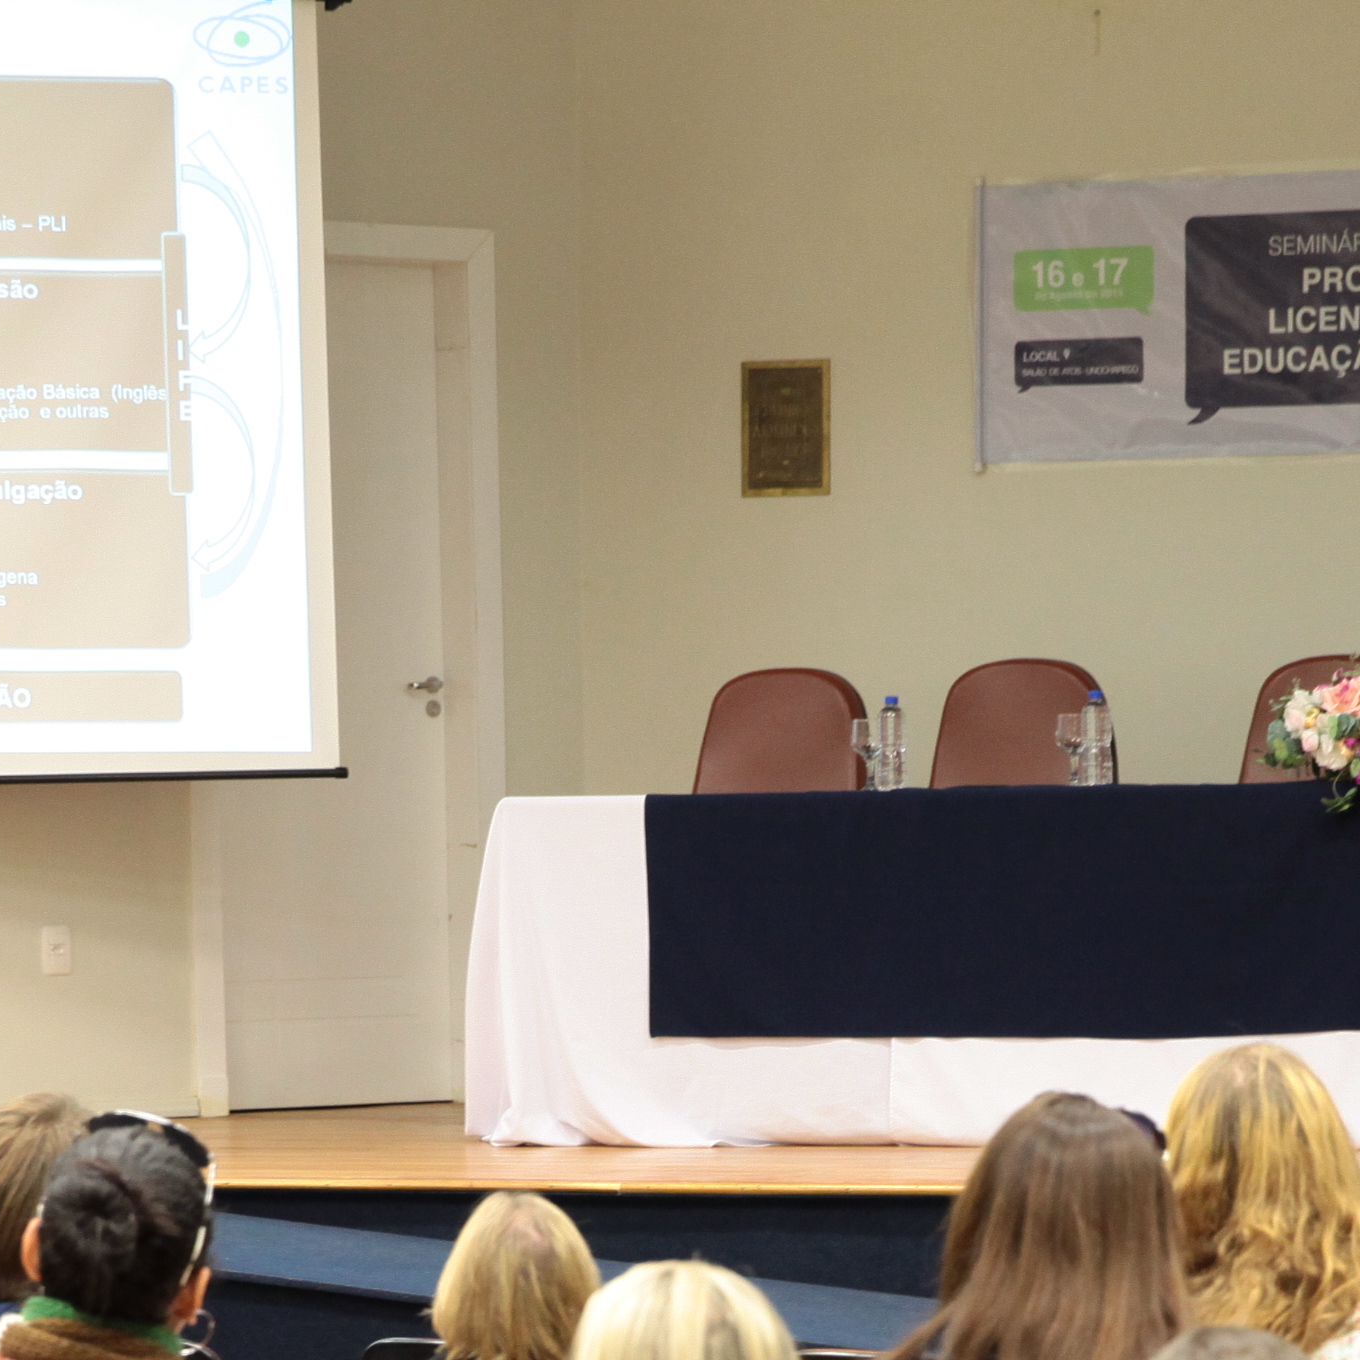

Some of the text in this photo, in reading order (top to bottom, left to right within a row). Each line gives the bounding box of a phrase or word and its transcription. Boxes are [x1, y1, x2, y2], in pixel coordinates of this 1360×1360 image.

[198, 75, 289, 94] CAPES
[38, 215, 66, 232] PLI
[1032, 258, 1128, 288] 16 e 17
[1023, 351, 1060, 362] LOCAL
[43, 384, 100, 399] Básica
[40, 407, 51, 418] e
[56, 404, 109, 418] outras
